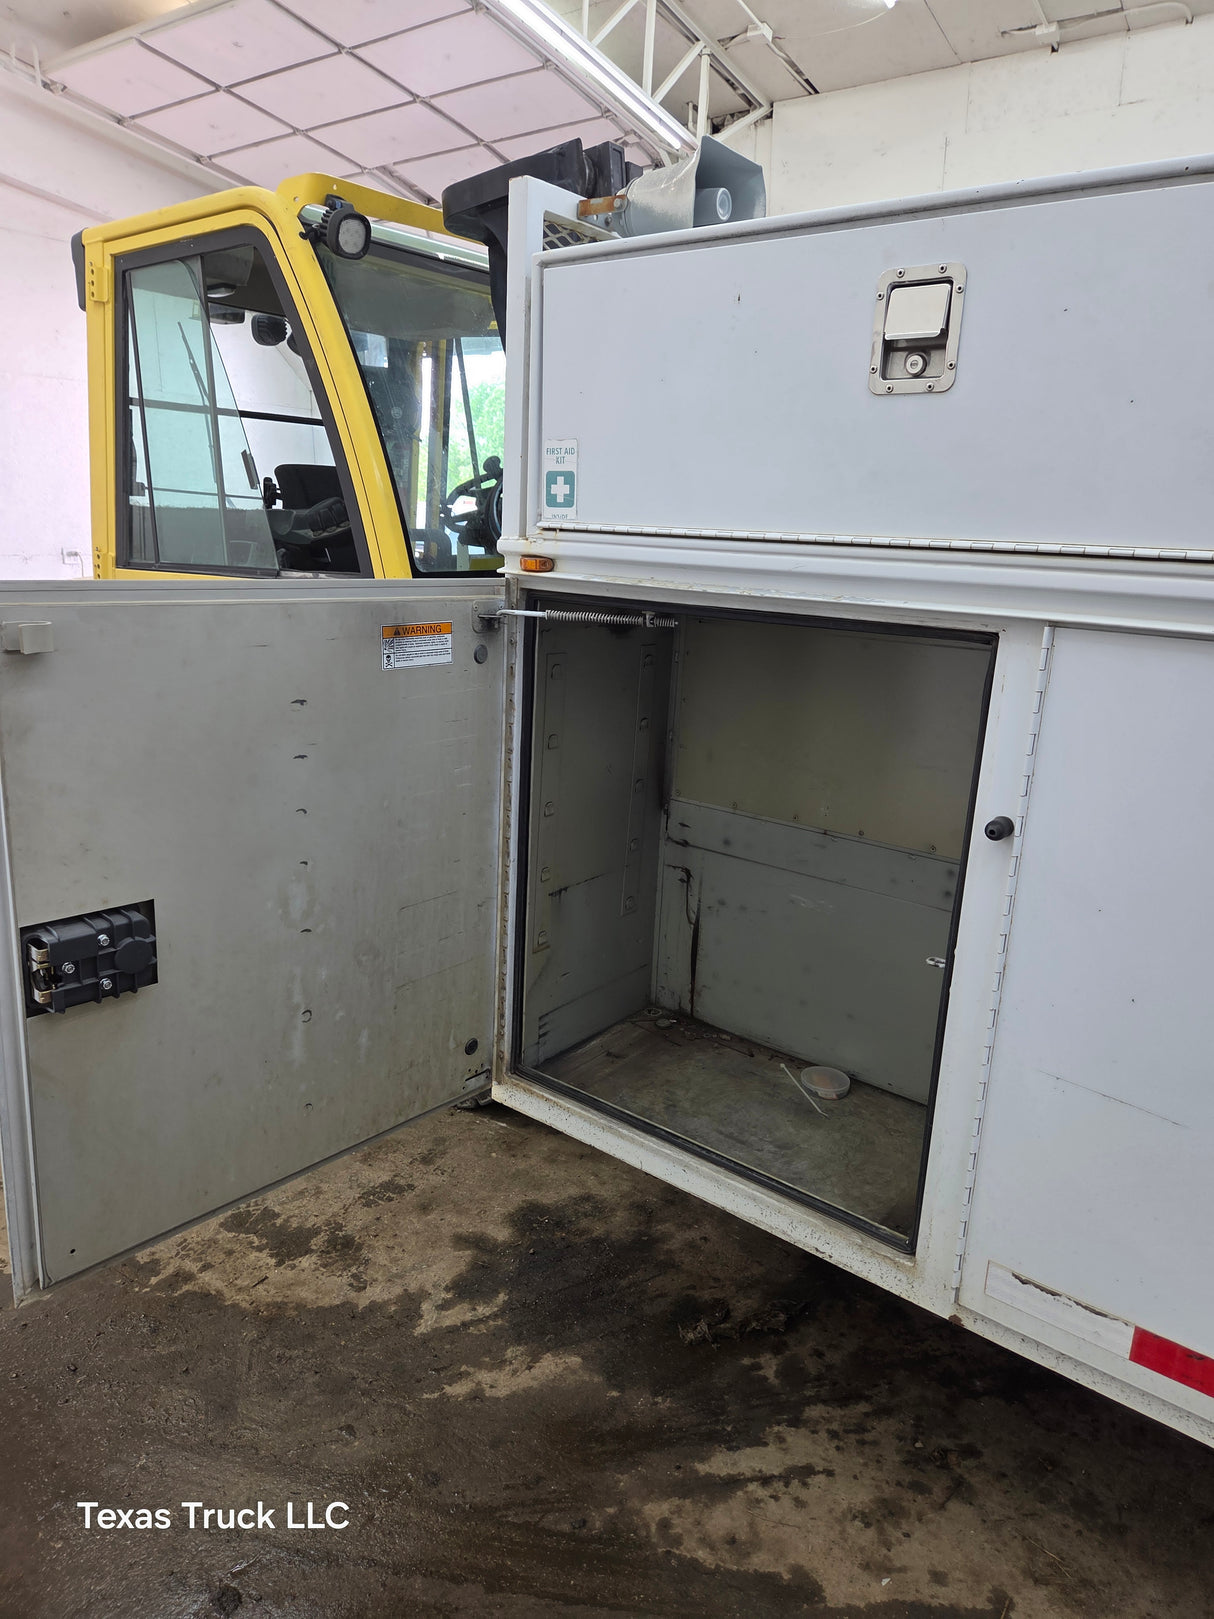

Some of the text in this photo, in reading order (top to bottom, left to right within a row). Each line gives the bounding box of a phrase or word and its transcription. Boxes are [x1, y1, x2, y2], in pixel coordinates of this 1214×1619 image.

[546, 447, 576, 455] FIRST AID
[555, 456, 566, 464] KIT
[402, 624, 442, 636] WARNING
